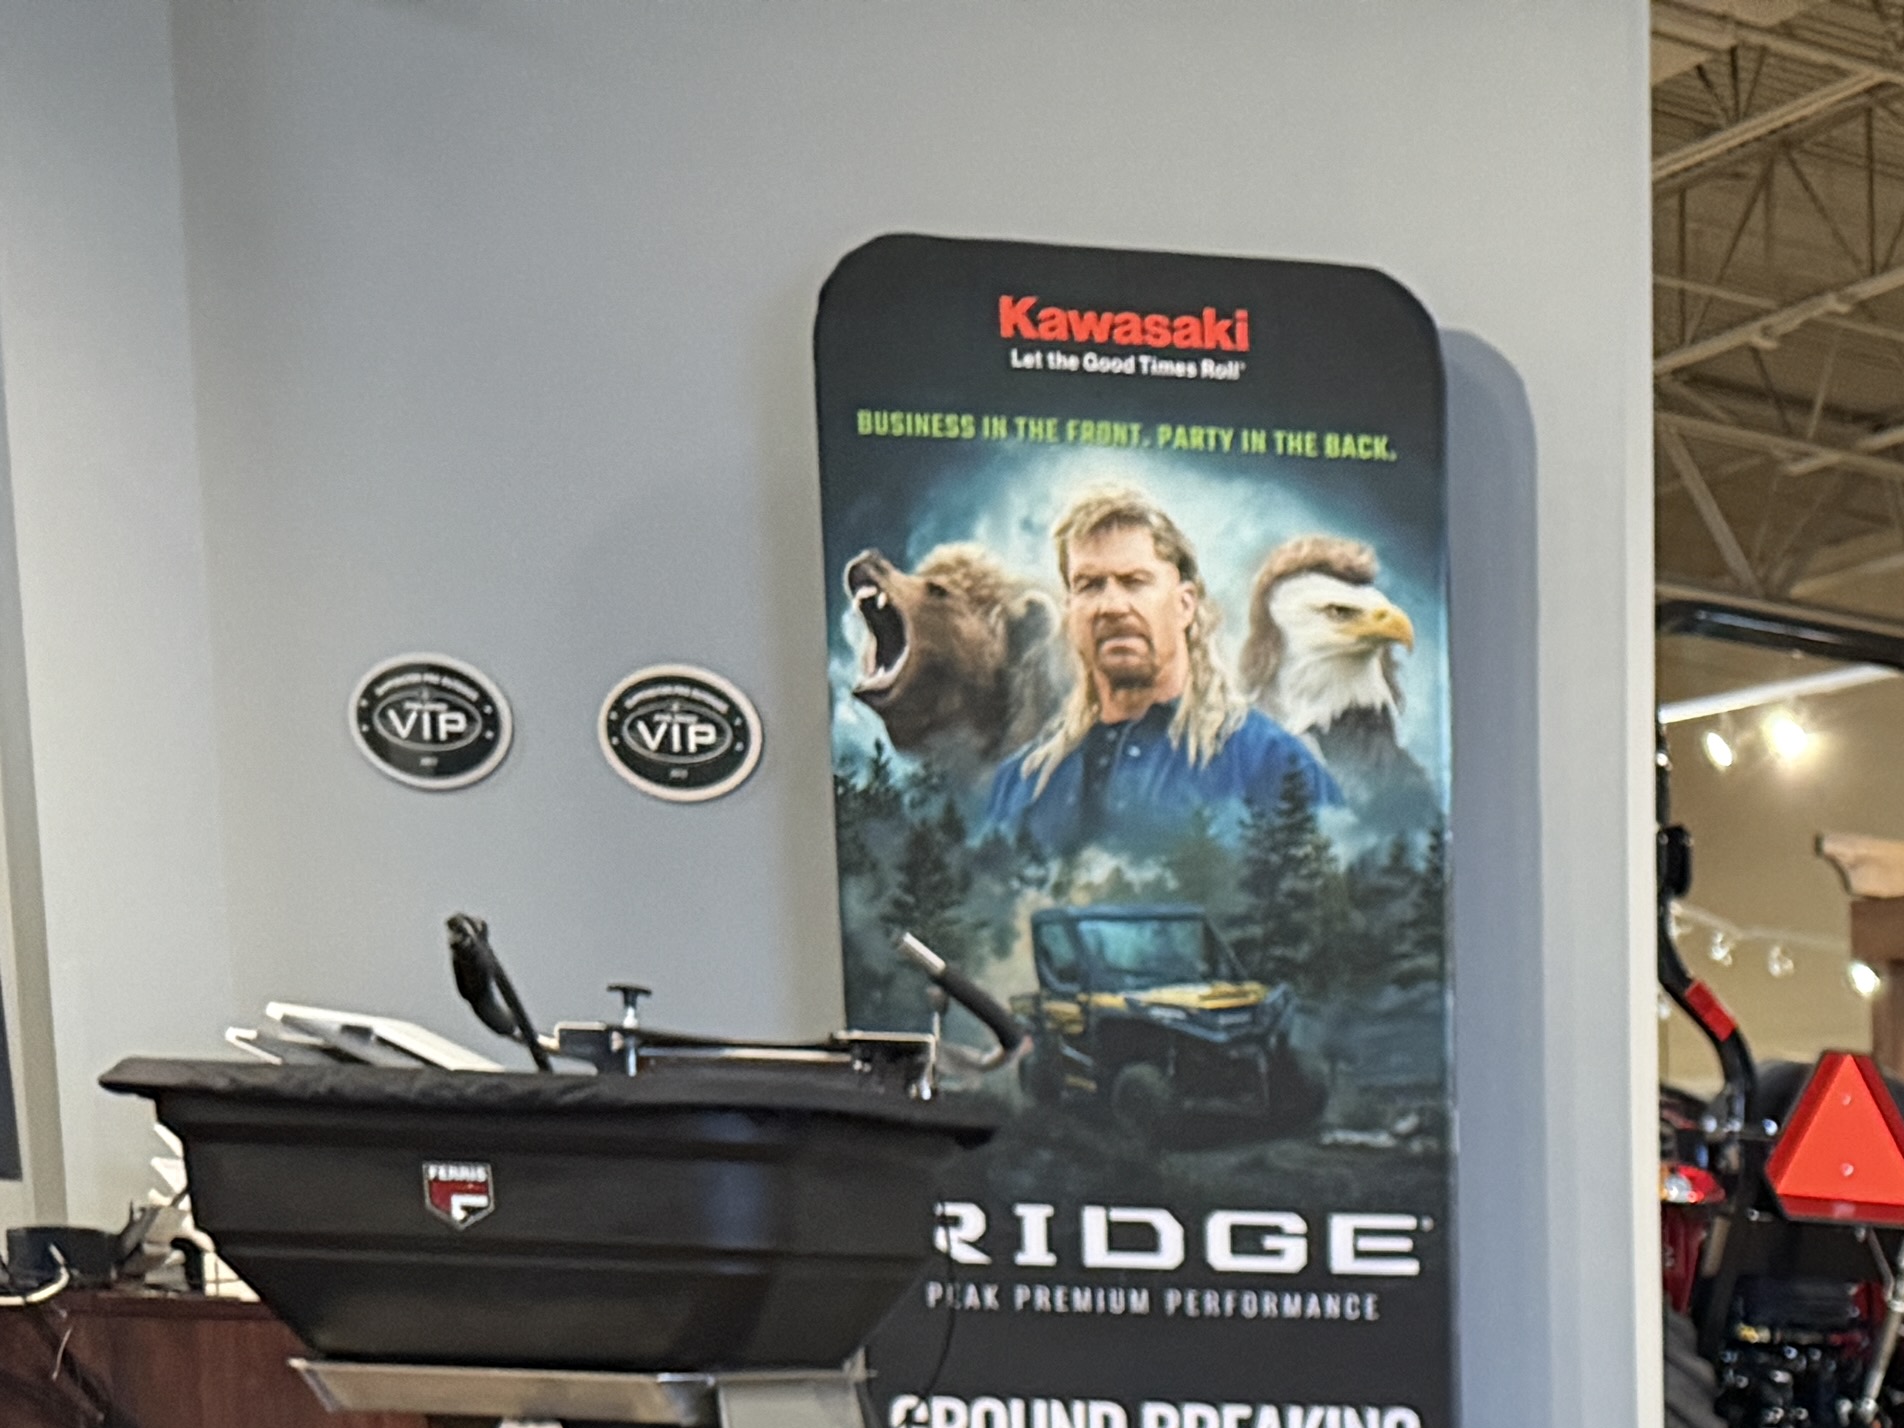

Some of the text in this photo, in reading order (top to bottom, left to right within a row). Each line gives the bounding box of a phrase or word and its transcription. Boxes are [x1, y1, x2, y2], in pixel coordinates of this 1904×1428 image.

[998, 294, 1250, 352] Kawasaki
[1010, 348, 1043, 370] Let
[1046, 350, 1081, 372] the
[1082, 351, 1136, 375] Good
[1138, 355, 1198, 379] Times
[857, 408, 1398, 462] BUSINESS IN THE FRONT. PARTY IN THE BACK.
[387, 707, 468, 742] VIP
[636, 719, 717, 753] VIP
[1014, 1284, 1151, 1316] PREMIUM
[1165, 1288, 1381, 1322] PERFORMANCE
